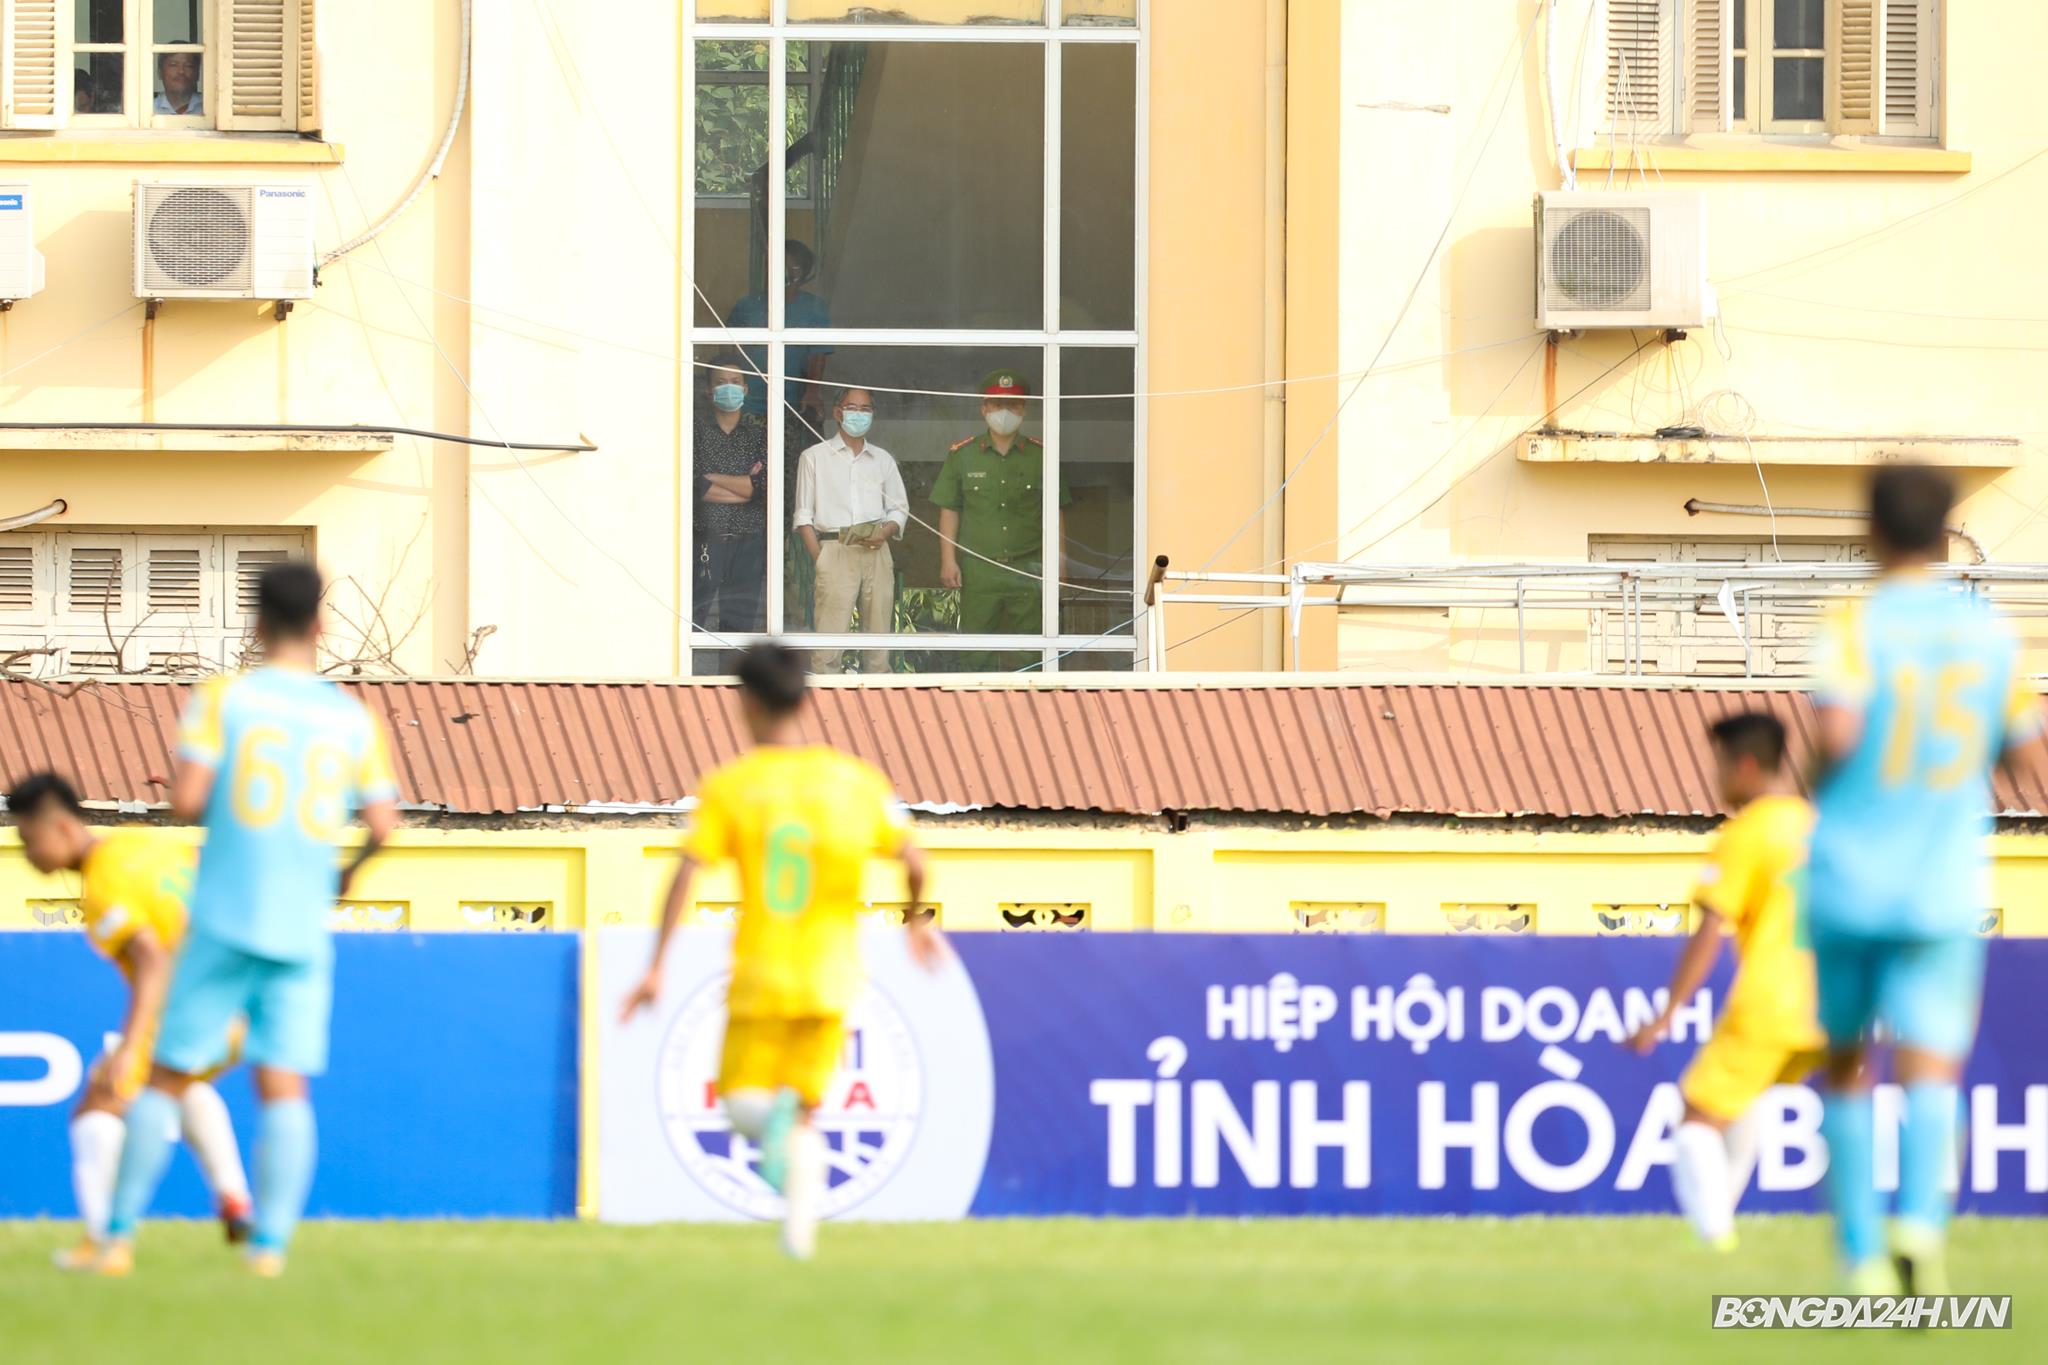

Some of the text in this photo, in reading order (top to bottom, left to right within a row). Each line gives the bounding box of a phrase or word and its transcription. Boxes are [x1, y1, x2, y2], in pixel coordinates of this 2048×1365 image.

[259, 189, 306, 198] Panasonic
[1882, 664, 1984, 788] 15
[231, 724, 351, 844] 68
[765, 823, 811, 913] 6
[1206, 972, 1713, 1055] HIỆP HỘI DOANH
[1090, 1036, 2048, 1193] TỈNH HÒA BNH
